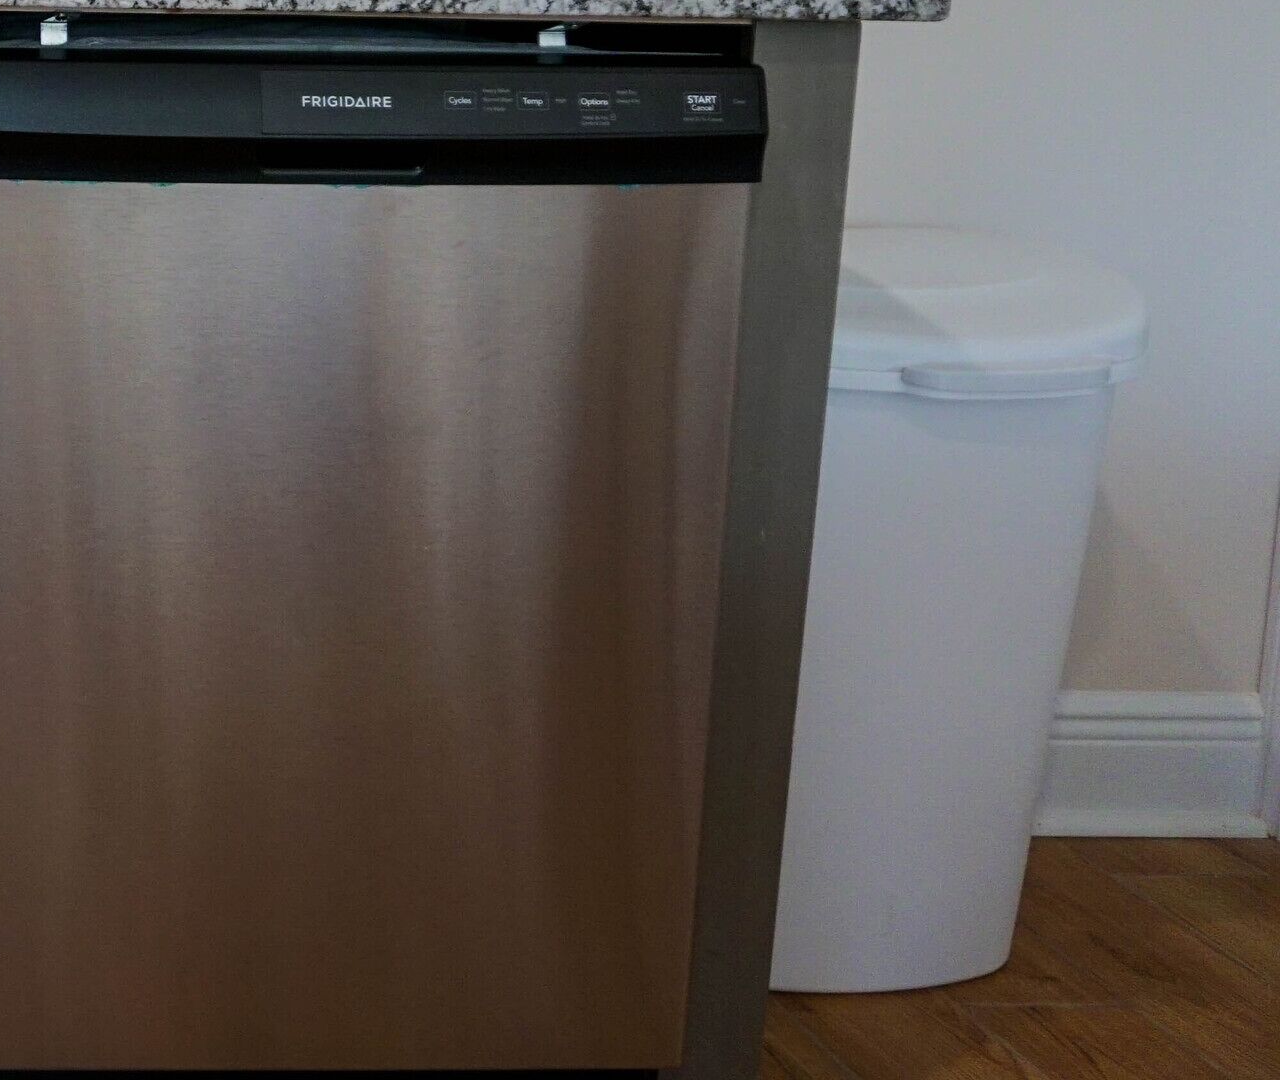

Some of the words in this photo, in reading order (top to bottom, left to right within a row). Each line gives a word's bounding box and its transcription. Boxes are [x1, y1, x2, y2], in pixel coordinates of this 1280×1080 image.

[301, 95, 392, 108] FRIGIDAIRE
[448, 96, 472, 106] Cycles
[522, 97, 544, 107] Temp
[580, 97, 609, 107] Options
[687, 95, 717, 104] START
[691, 104, 715, 112] Cancel
